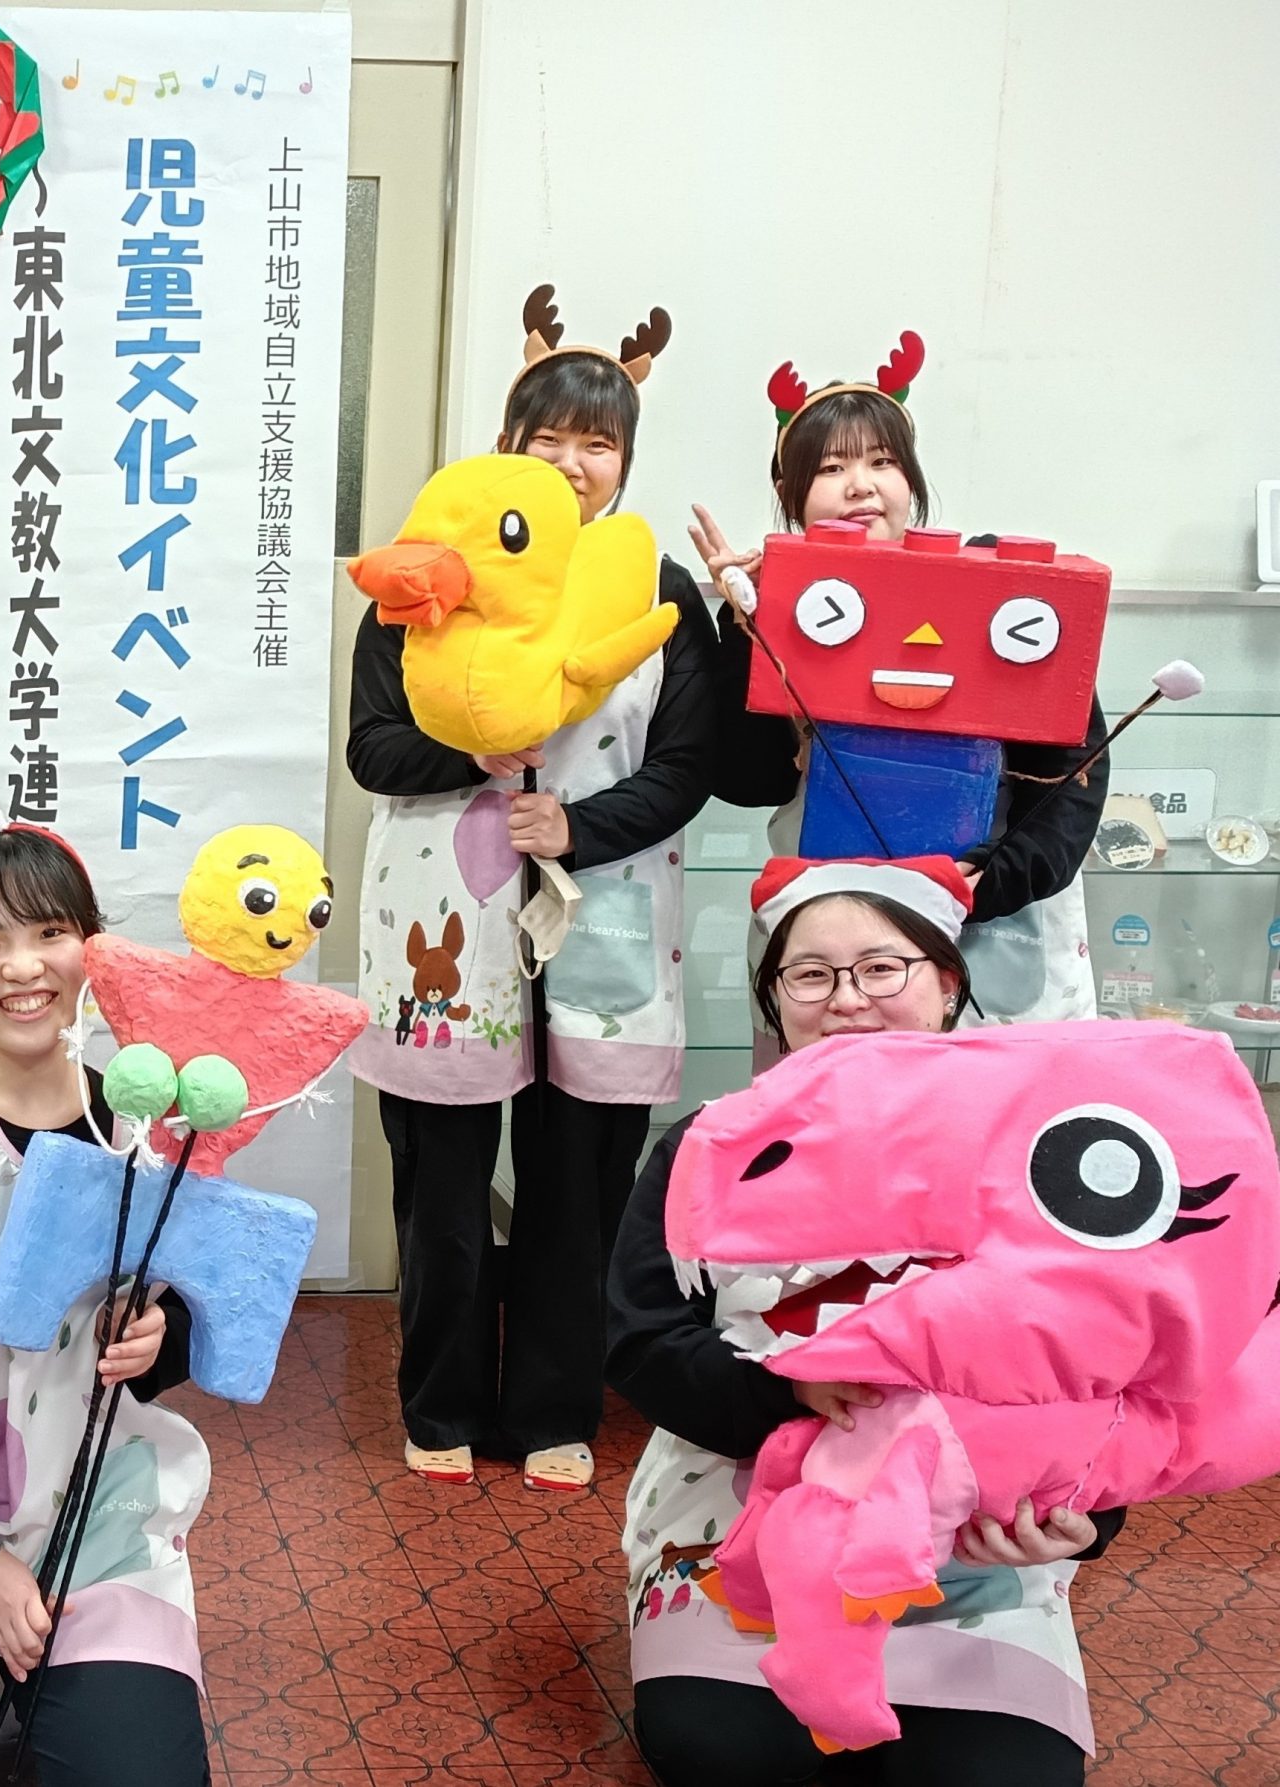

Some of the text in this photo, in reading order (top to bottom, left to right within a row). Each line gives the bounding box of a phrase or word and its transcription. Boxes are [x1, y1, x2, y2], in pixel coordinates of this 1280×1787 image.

[111, 137, 205, 850] 児童文化イベント
[252, 136, 304, 668] 上山市地域自立支援協議会主催
